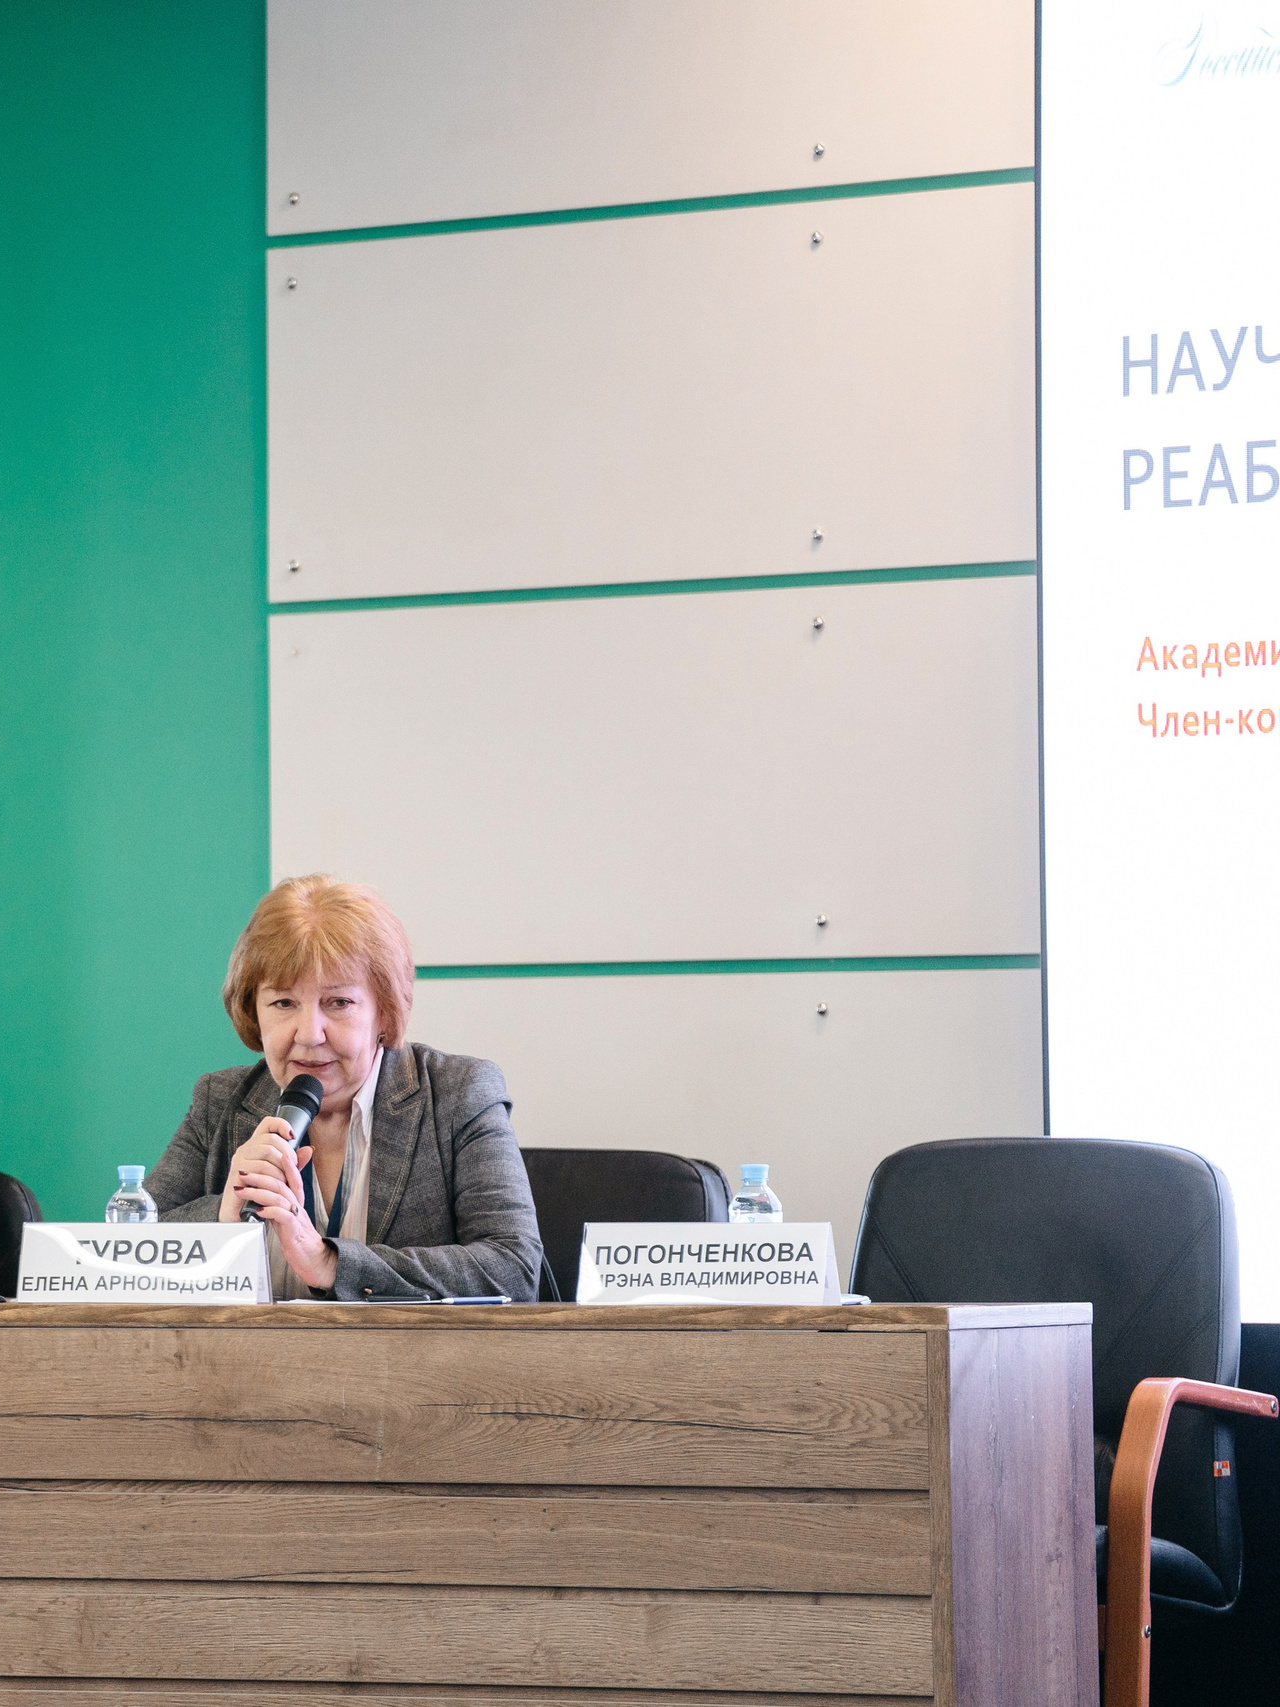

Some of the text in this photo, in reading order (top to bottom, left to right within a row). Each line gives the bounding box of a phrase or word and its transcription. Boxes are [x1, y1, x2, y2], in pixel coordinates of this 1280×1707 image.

[1122, 439, 1280, 511] РЕАБ
[1137, 702, 1280, 739] Член-ко
[595, 1242, 814, 1266] ПОГОНЧЕНКОВА
[21, 1276, 89, 1292] ЕЛЕНА
[600, 1270, 819, 1289] РЭНА ВЛАДИМИРОВНА
